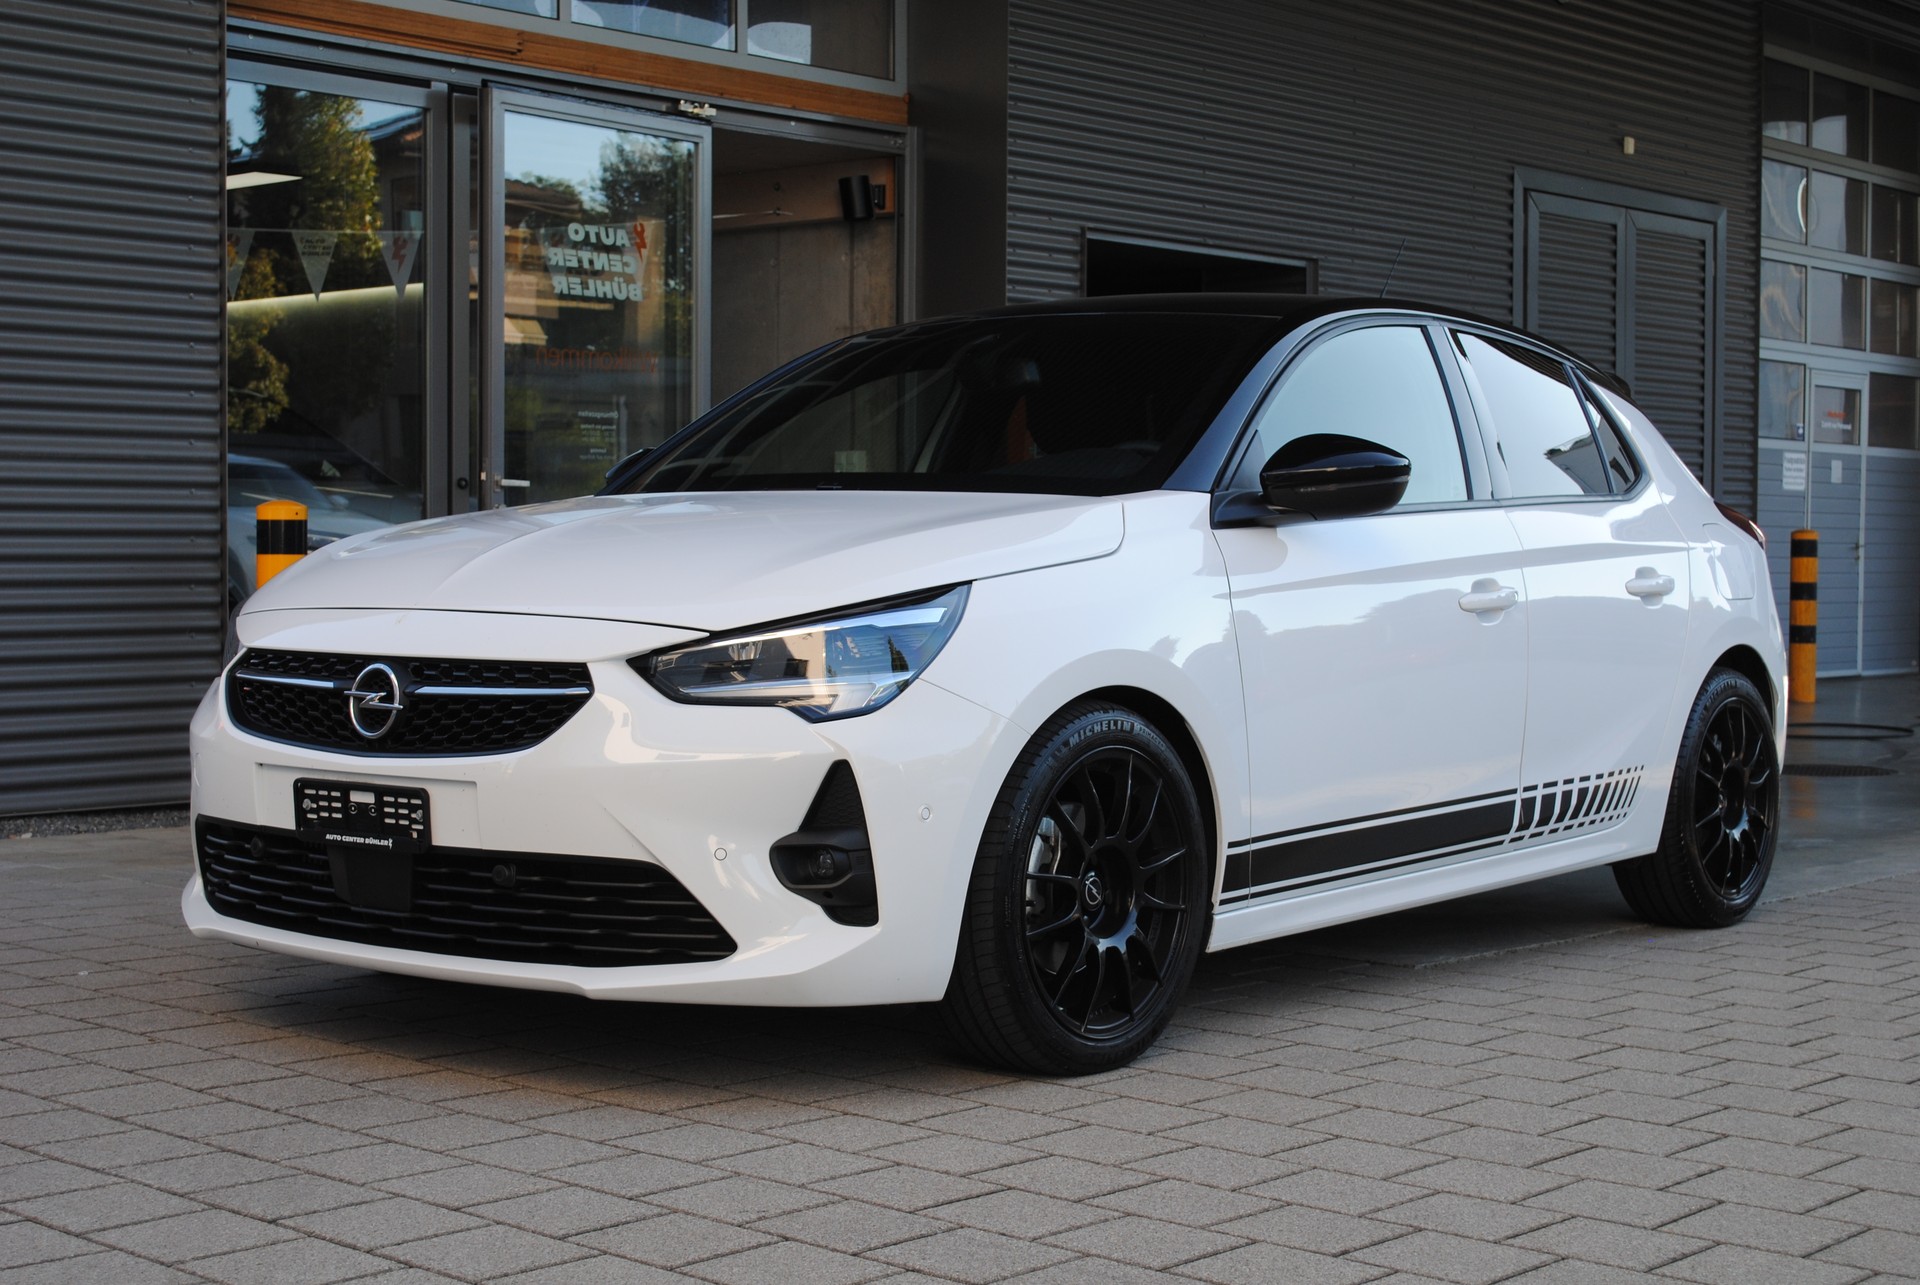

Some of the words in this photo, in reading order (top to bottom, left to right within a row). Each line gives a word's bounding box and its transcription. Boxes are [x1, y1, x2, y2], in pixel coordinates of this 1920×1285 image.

[1069, 719, 1131, 748] MICHELIN
[342, 835, 364, 843] CENTER
[365, 837, 389, 845] BÜHLER
